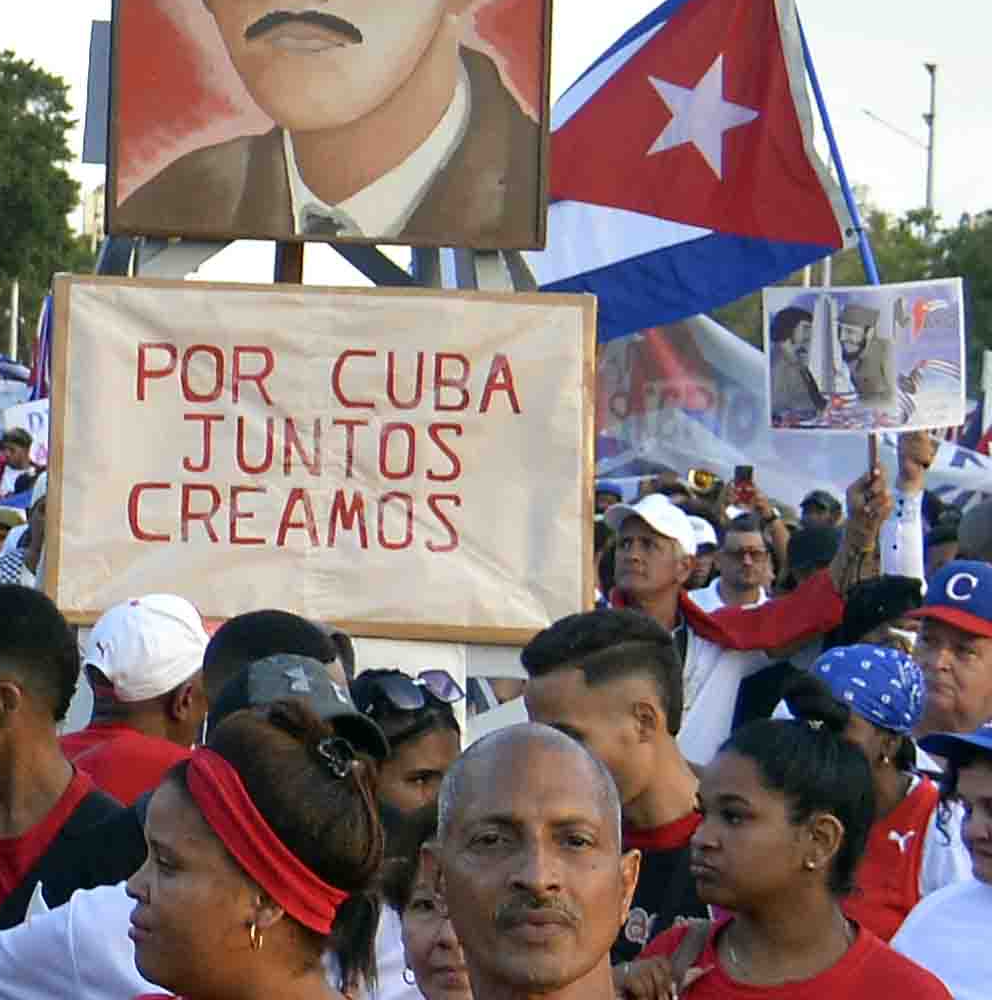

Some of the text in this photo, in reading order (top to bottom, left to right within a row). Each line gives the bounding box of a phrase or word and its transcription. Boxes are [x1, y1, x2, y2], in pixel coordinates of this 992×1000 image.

[135, 341, 522, 415] POR CUBA
[182, 412, 464, 483] JUNTOS
[127, 482, 463, 553] CREAMOS
[946, 572, 978, 600] C
